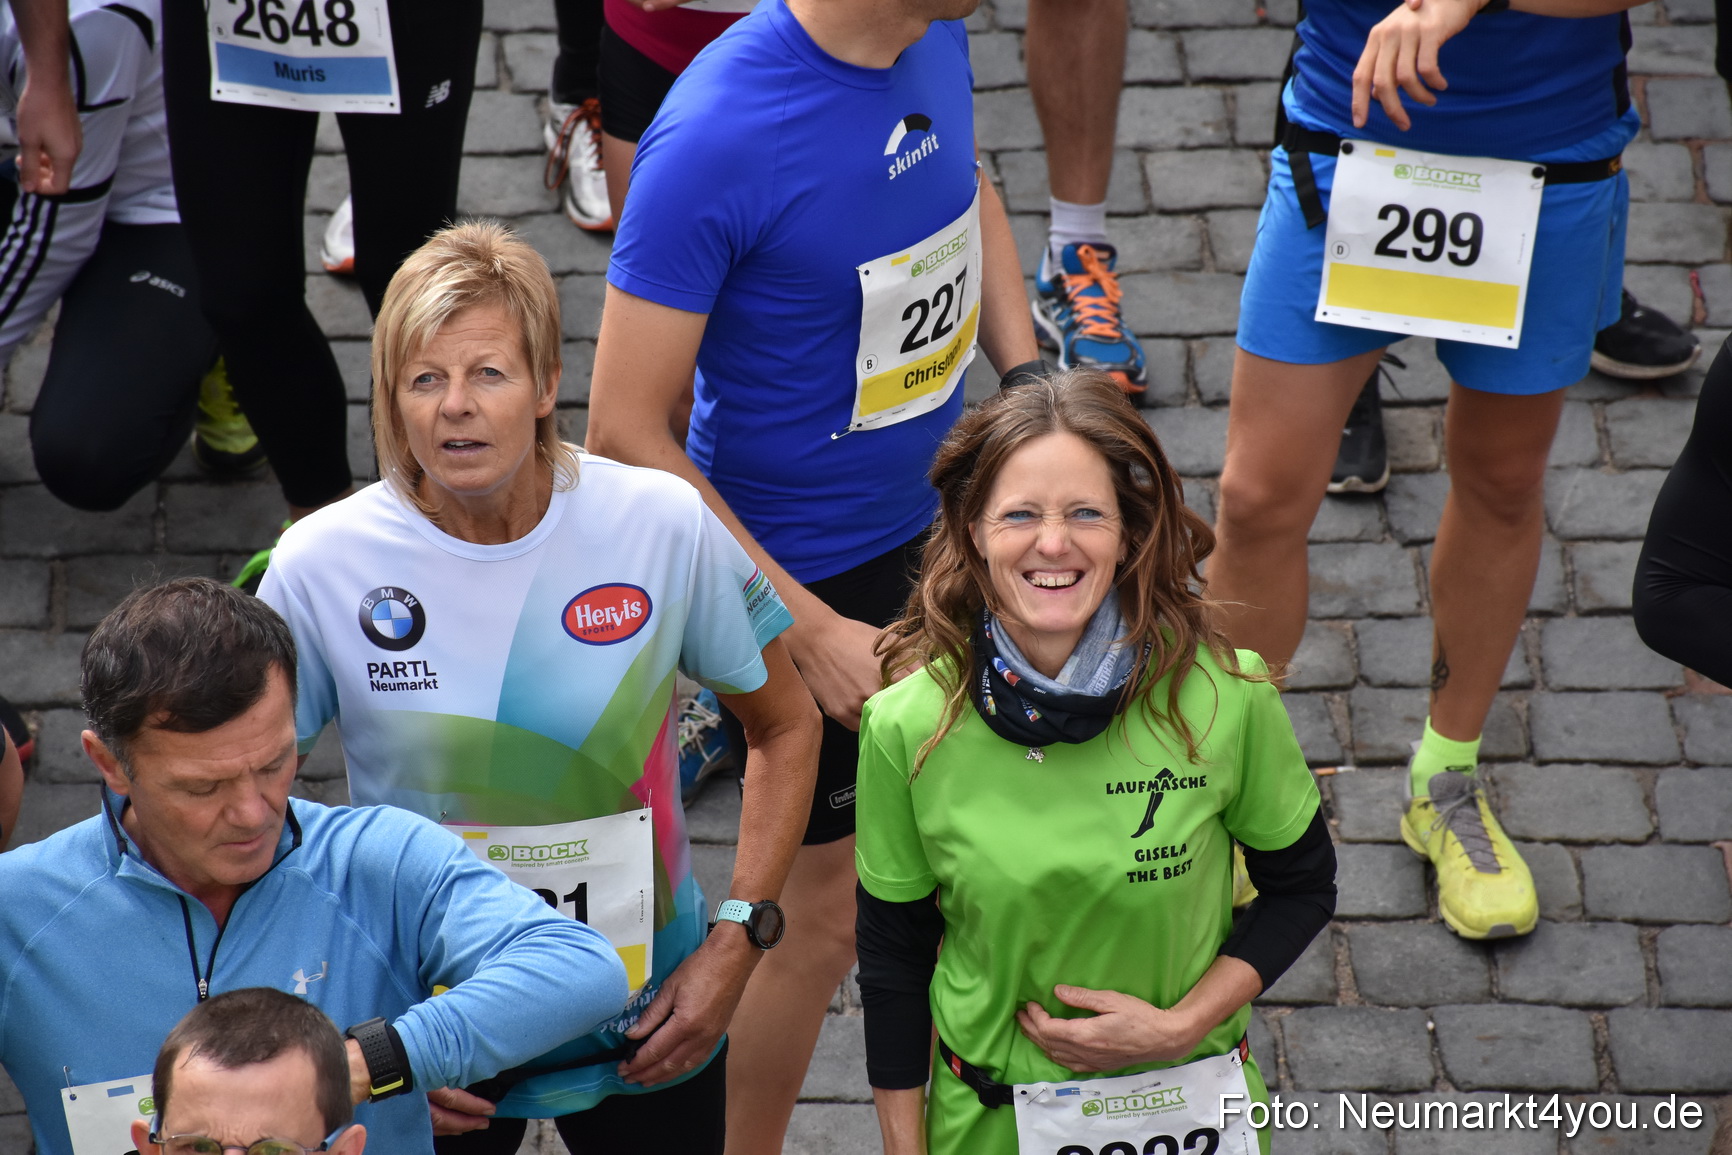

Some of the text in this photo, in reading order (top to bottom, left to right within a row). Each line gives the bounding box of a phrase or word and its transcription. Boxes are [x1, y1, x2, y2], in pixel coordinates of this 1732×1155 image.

[229, 0, 359, 47] 2648
[274, 61, 326, 83] Muris
[888, 132, 939, 180] skinfit
[1412, 165, 1482, 188] BOCK
[1374, 203, 1484, 267] 299
[925, 227, 968, 271] BOCK
[149, 276, 186, 298] asics
[900, 261, 968, 355] 227
[362, 588, 418, 611] BMW
[574, 598, 643, 629] Hervis
[582, 624, 616, 636] SPORTS
[366, 660, 437, 679] PARTL
[370, 678, 439, 692] Neumarkt
[1106, 775, 1207, 795] LAUFMASCHE
[511, 839, 589, 862] BOCK
[1134, 843, 1187, 863] GISELA
[1127, 858, 1193, 883] THE BEST
[1105, 1086, 1187, 1114] BOCK
[1106, 1112, 1132, 1120] inspired
[1161, 1105, 1188, 1114] concepts
